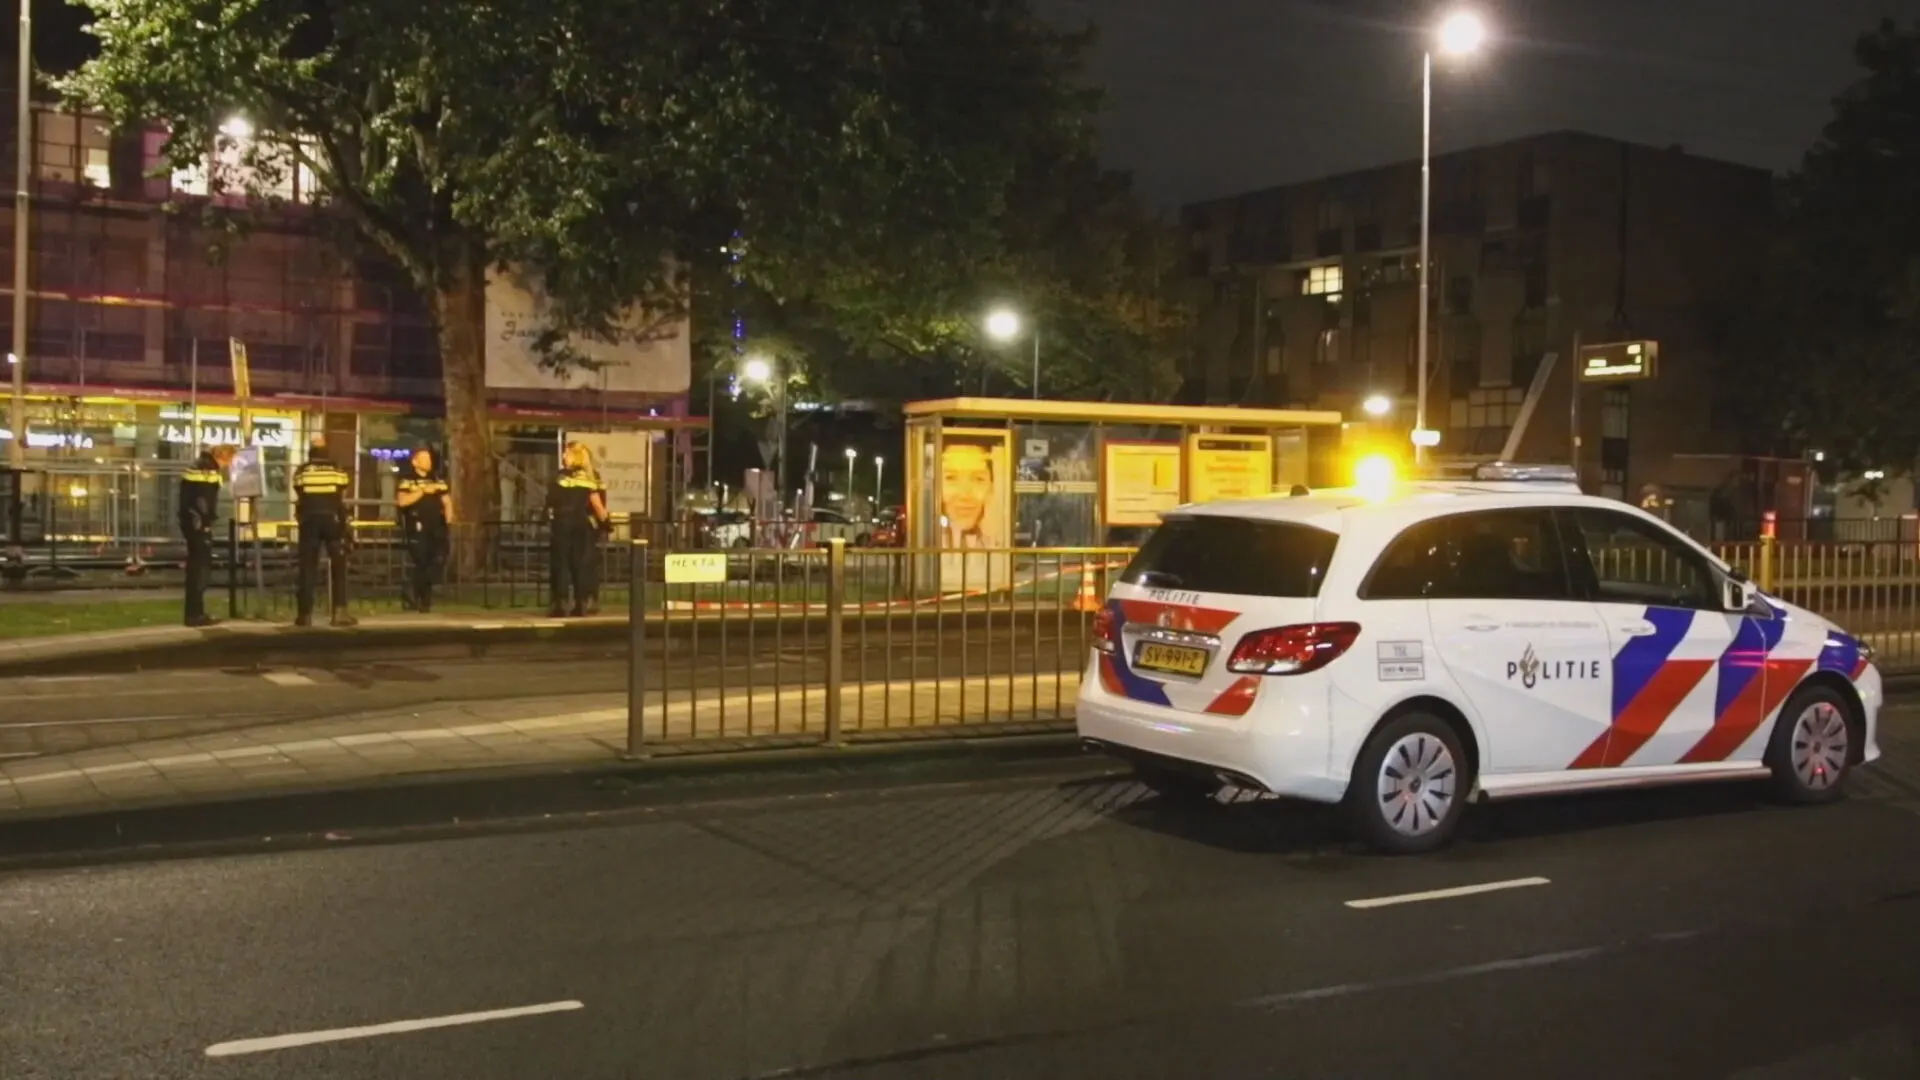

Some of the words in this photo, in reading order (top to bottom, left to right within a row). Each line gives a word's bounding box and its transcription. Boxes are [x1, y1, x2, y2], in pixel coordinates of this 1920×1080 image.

[1149, 588, 1201, 605] POLITIE
[1144, 646, 1201, 670] SV-991-Z
[1506, 655, 1600, 688] POLITIE
